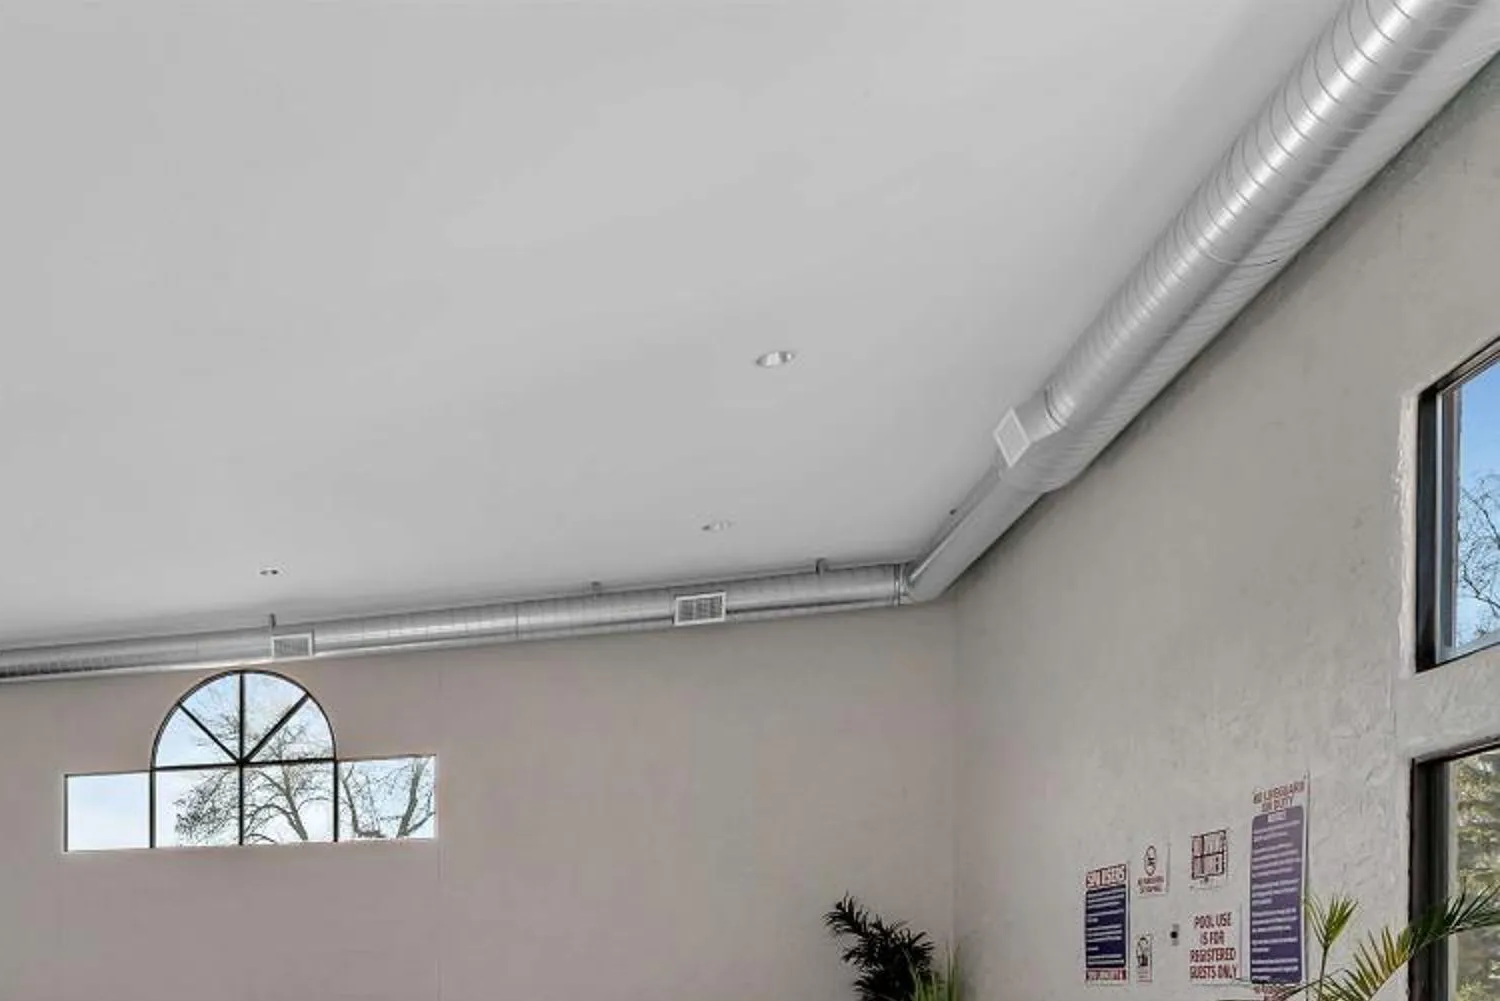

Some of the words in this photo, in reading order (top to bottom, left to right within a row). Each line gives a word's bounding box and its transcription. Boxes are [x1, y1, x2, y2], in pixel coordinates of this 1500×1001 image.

[1194, 915, 1214, 928] POOL
[1216, 912, 1232, 926] USE
[1200, 931, 1208, 945] IS
[1209, 931, 1224, 945] FOR
[1190, 948, 1236, 963] REGISTERED
[1190, 966, 1216, 979] GUESTS
[1218, 965, 1237, 979] ONLY
